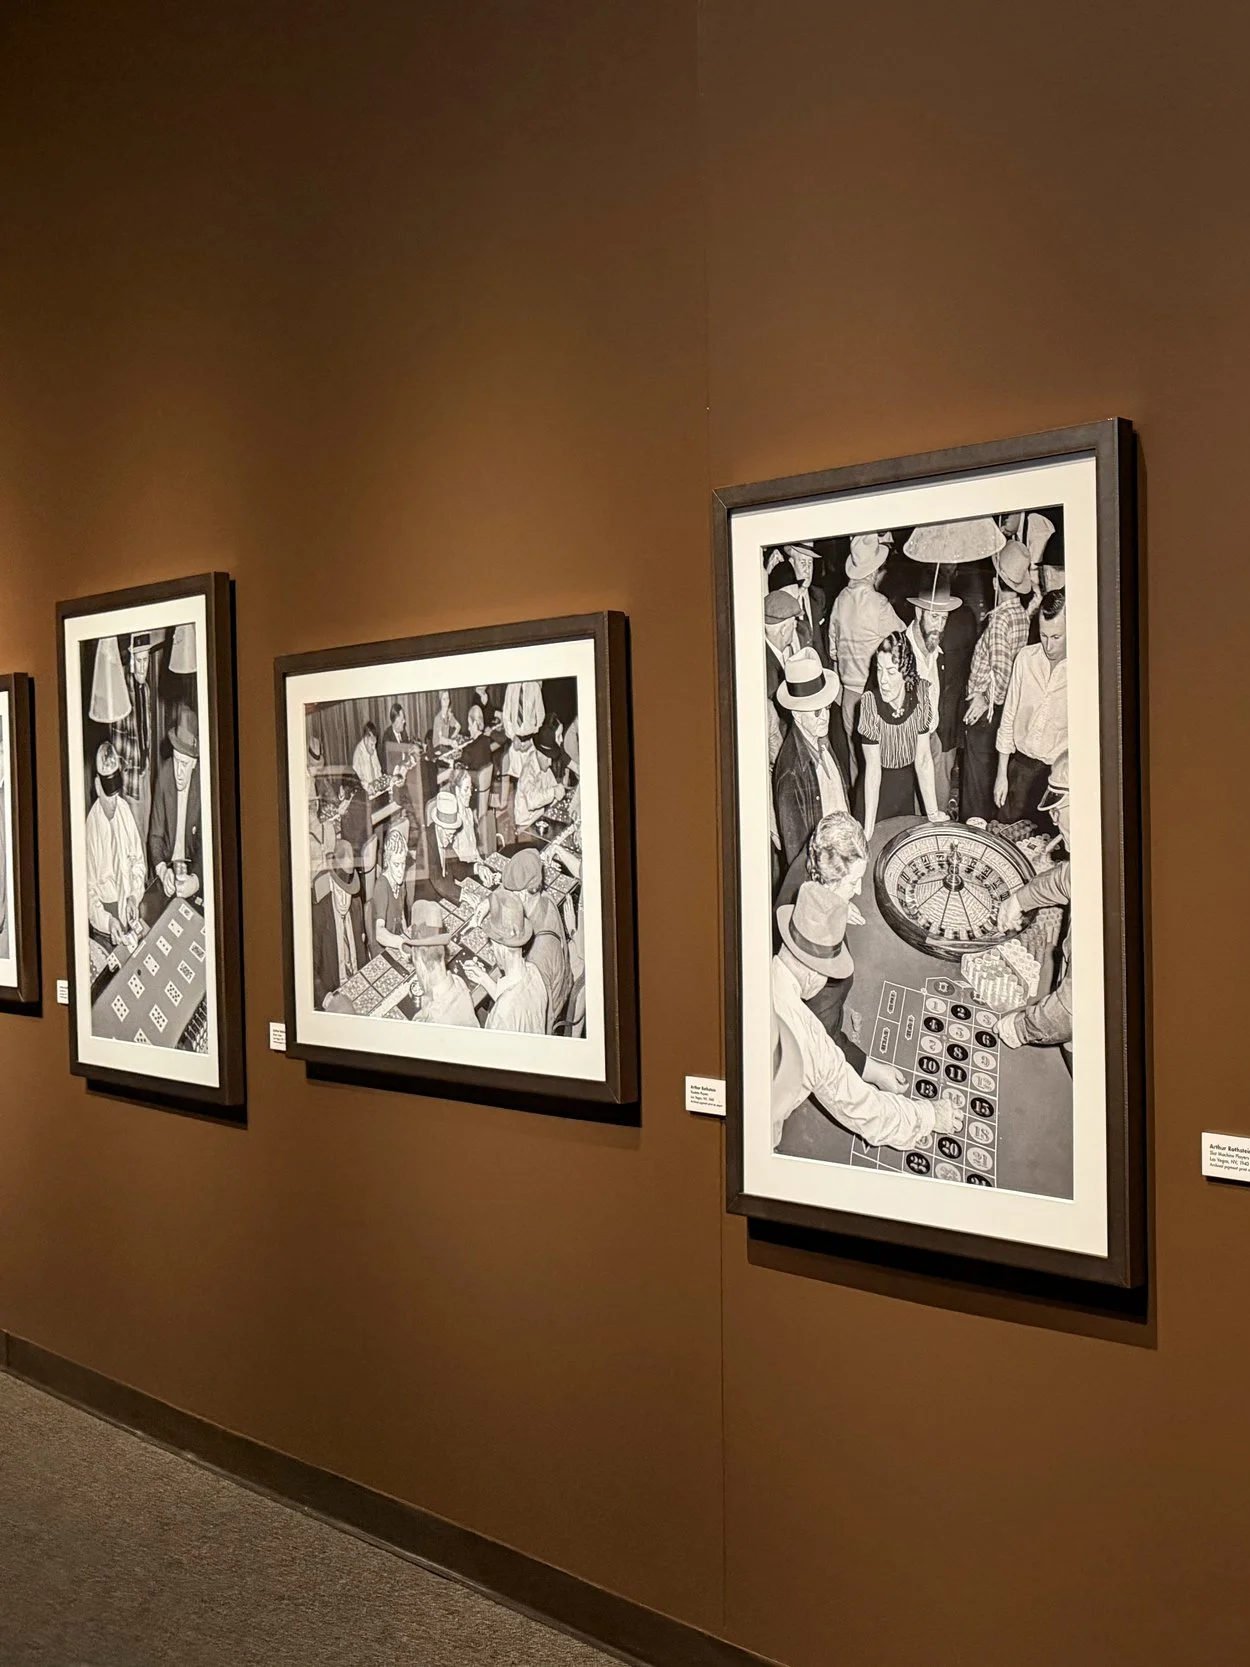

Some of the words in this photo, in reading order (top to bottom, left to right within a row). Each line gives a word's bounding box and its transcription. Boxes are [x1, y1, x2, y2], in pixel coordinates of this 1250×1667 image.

[922, 1058, 938, 1072] 10
[949, 1066, 963, 1081] 11
[920, 1082, 935, 1097] 13
[975, 1100, 991, 1116] 15
[942, 1139, 959, 1157] 20
[910, 1155, 928, 1173] 22
